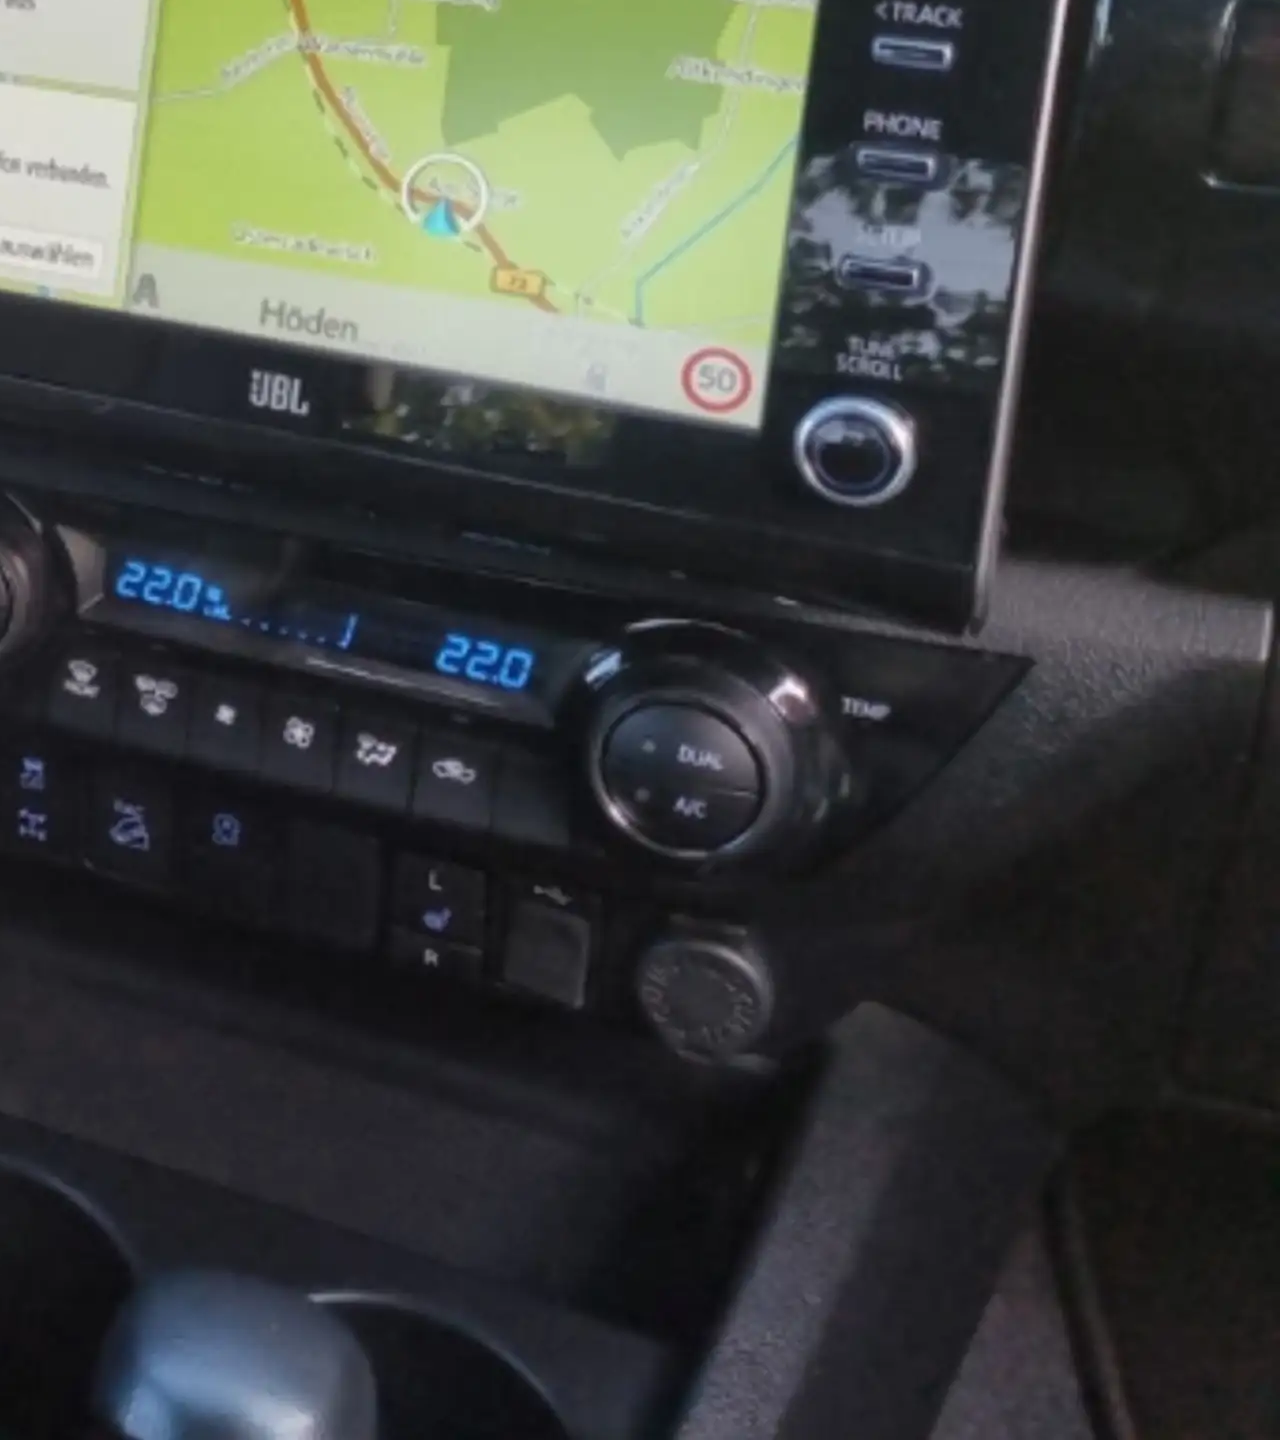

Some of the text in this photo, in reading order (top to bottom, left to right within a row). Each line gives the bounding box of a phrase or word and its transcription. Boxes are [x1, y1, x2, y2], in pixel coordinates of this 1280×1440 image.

[863, 109, 943, 140] PHONE
[259, 297, 359, 341] Höden
[249, 368, 310, 417] JBL
[696, 364, 739, 394] 50
[435, 632, 534, 688] 22.0
[842, 696, 891, 721] TEMP
[676, 744, 724, 771] DUAL
